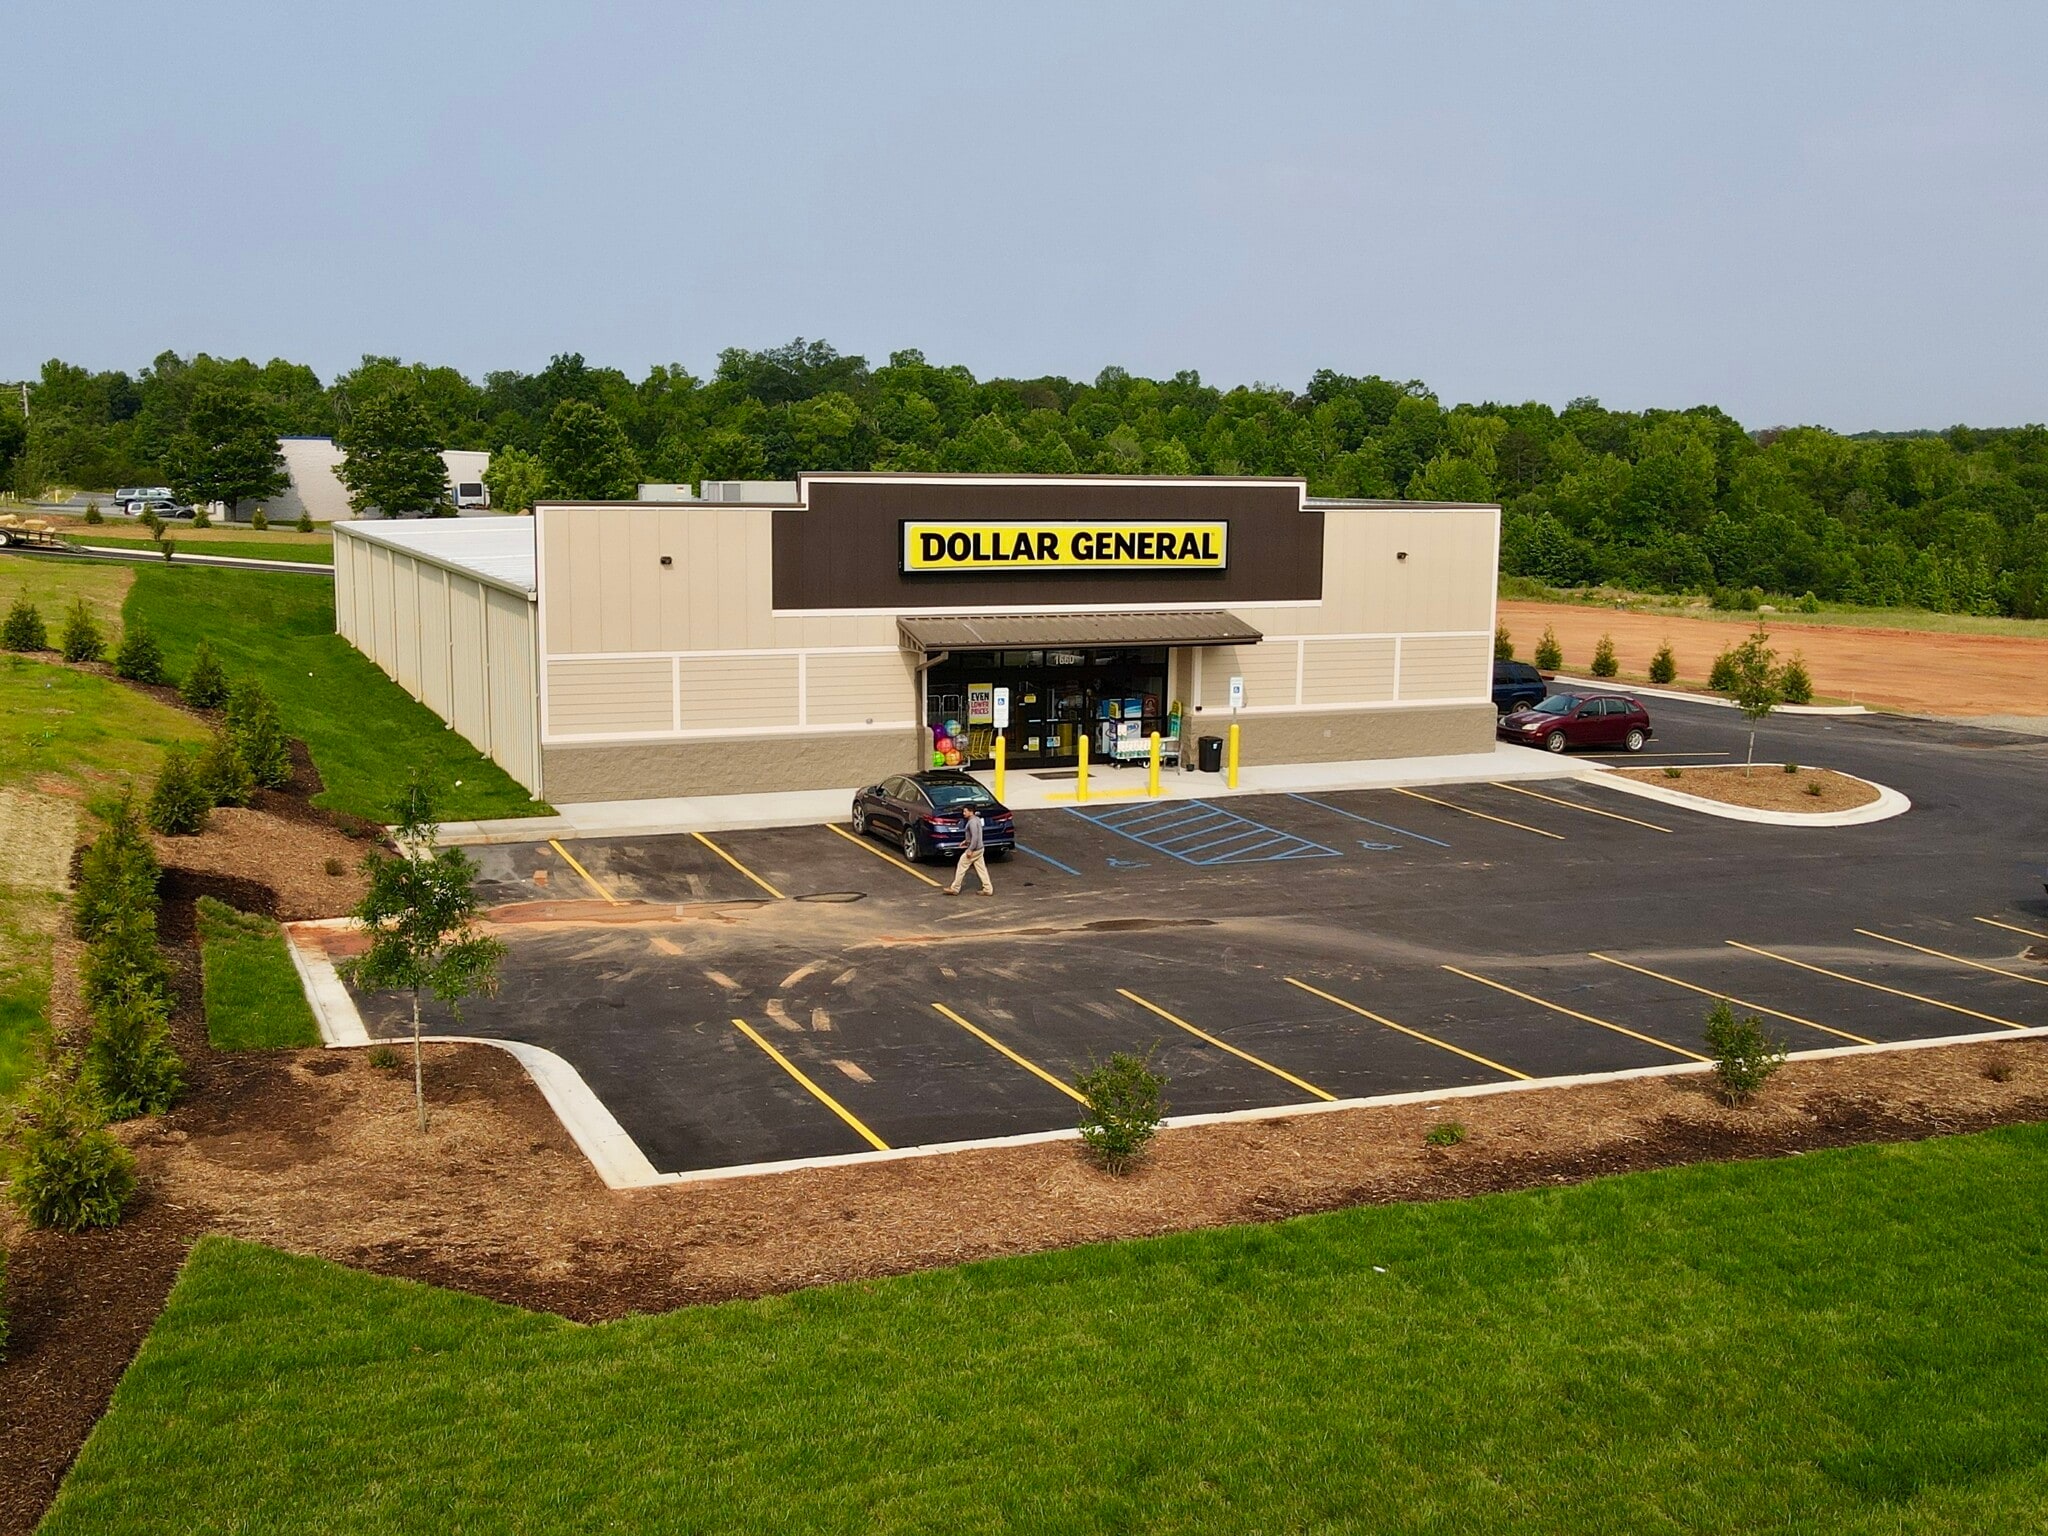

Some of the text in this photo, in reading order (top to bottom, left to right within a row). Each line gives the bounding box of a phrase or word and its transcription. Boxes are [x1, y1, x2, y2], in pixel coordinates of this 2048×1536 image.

[920, 532, 1218, 561] DOLLAR GENERAL
[971, 692, 989, 701] EVEN
